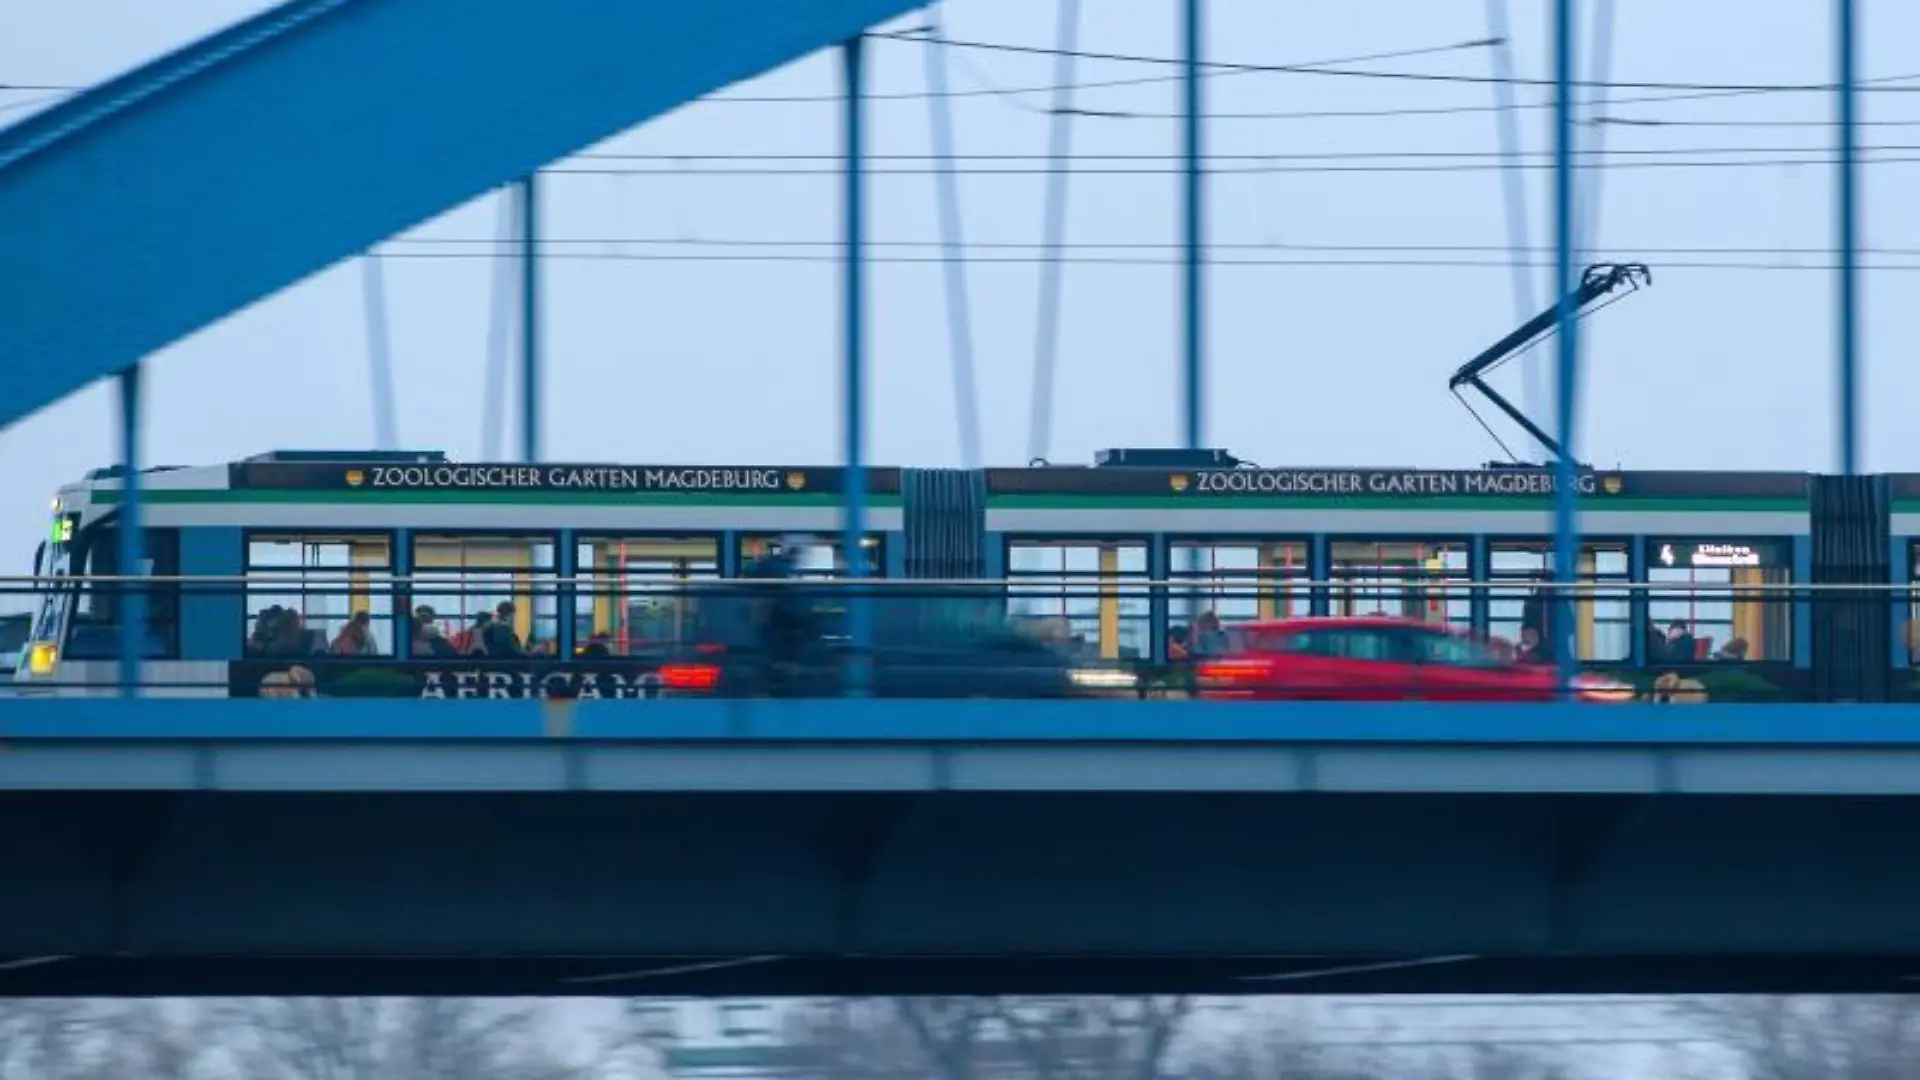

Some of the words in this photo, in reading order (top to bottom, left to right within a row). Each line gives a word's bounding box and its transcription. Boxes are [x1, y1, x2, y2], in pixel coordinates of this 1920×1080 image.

[372, 467, 541, 487] ZOOLOGISCHER
[548, 468, 636, 488] GARTEN
[645, 469, 779, 489] MAGDEBURG
[1196, 472, 1363, 492] ZOOLOGISCHER
[1369, 473, 1457, 492] GARTEN
[1661, 544, 1674, 565] 4
[420, 671, 664, 700] AFRICAM
